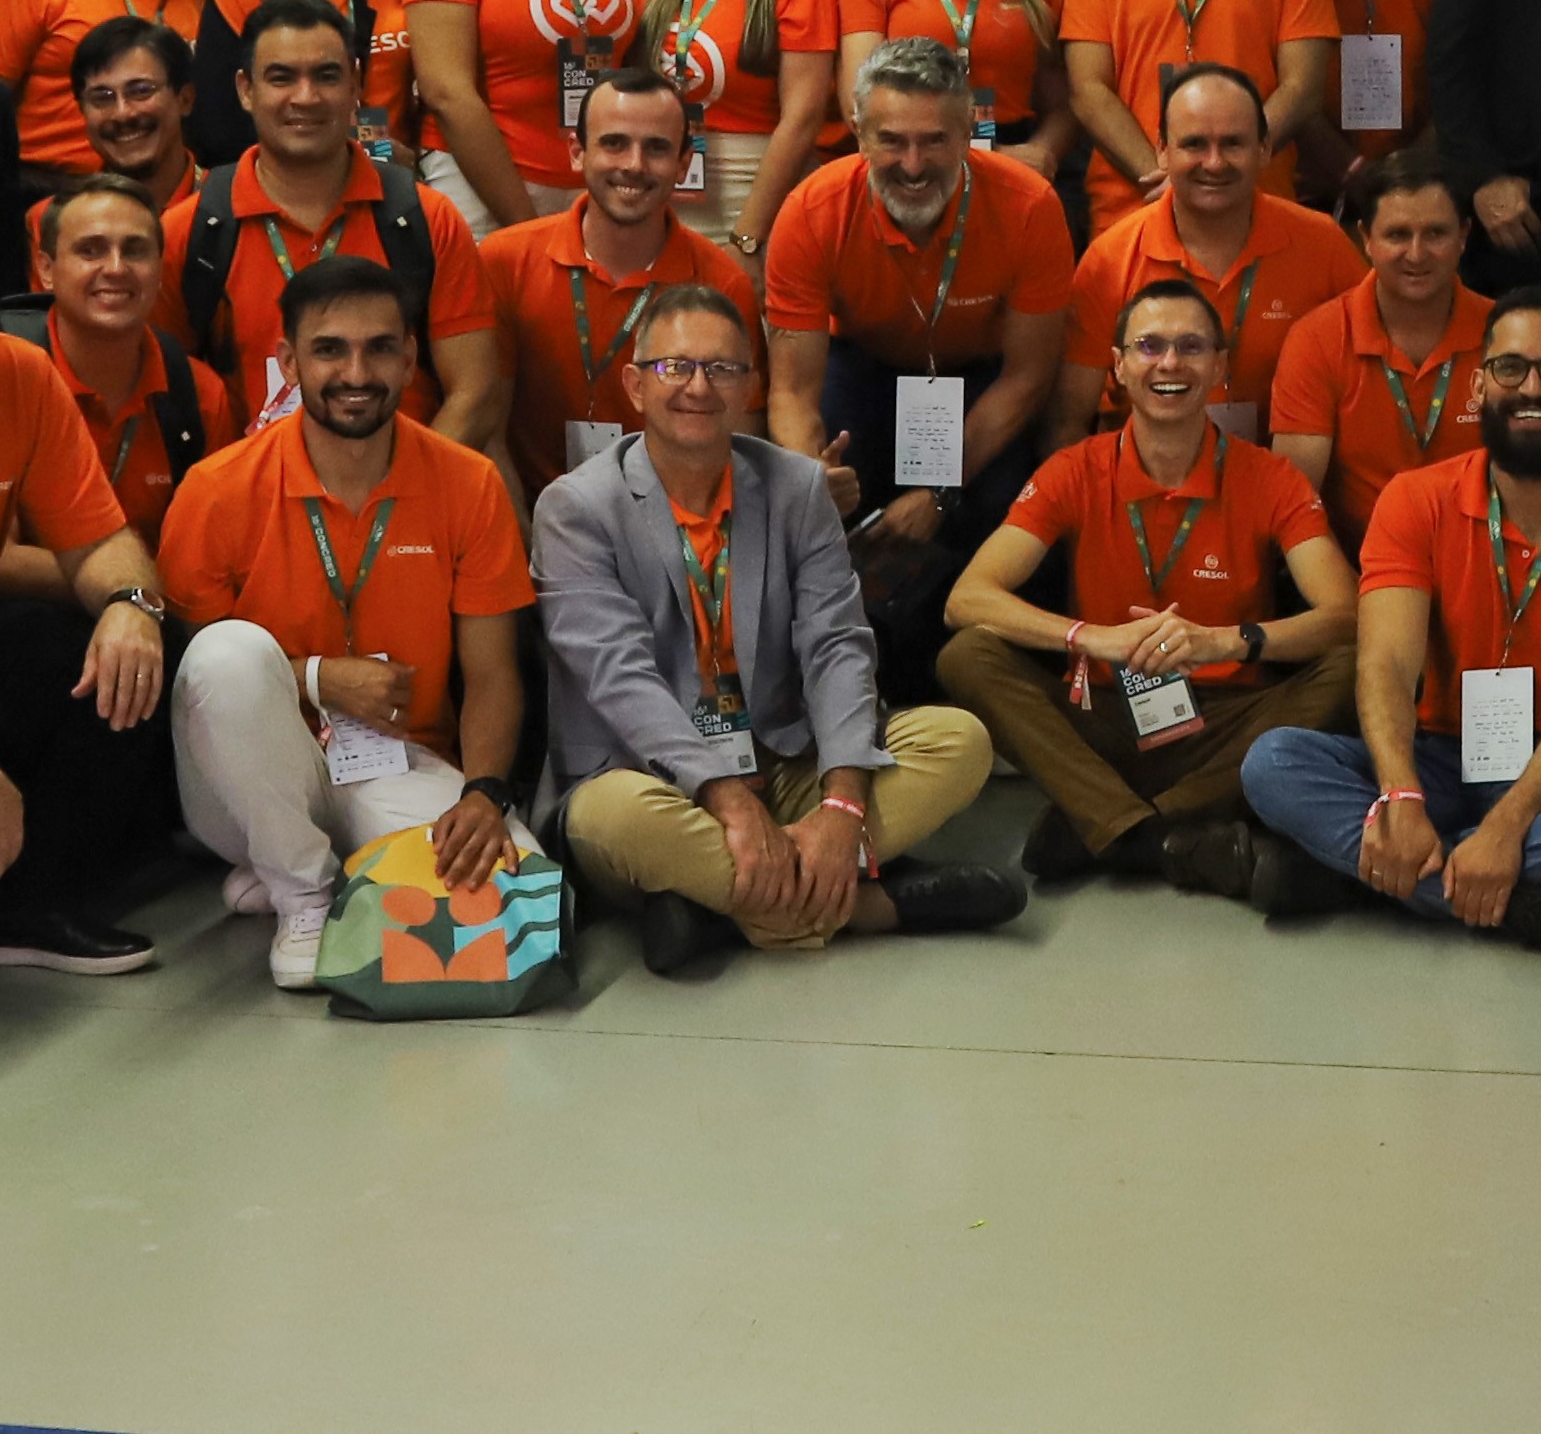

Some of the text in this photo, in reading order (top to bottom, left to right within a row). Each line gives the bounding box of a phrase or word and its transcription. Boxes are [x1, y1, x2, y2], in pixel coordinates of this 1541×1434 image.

[370, 30, 412, 55] ESO
[314, 527, 336, 578] CONCRED
[397, 545, 435, 555] CRESOL
[1192, 568, 1230, 580] CRESOL
[1123, 672, 1146, 687] CO
[1126, 676, 1163, 695] CRED
